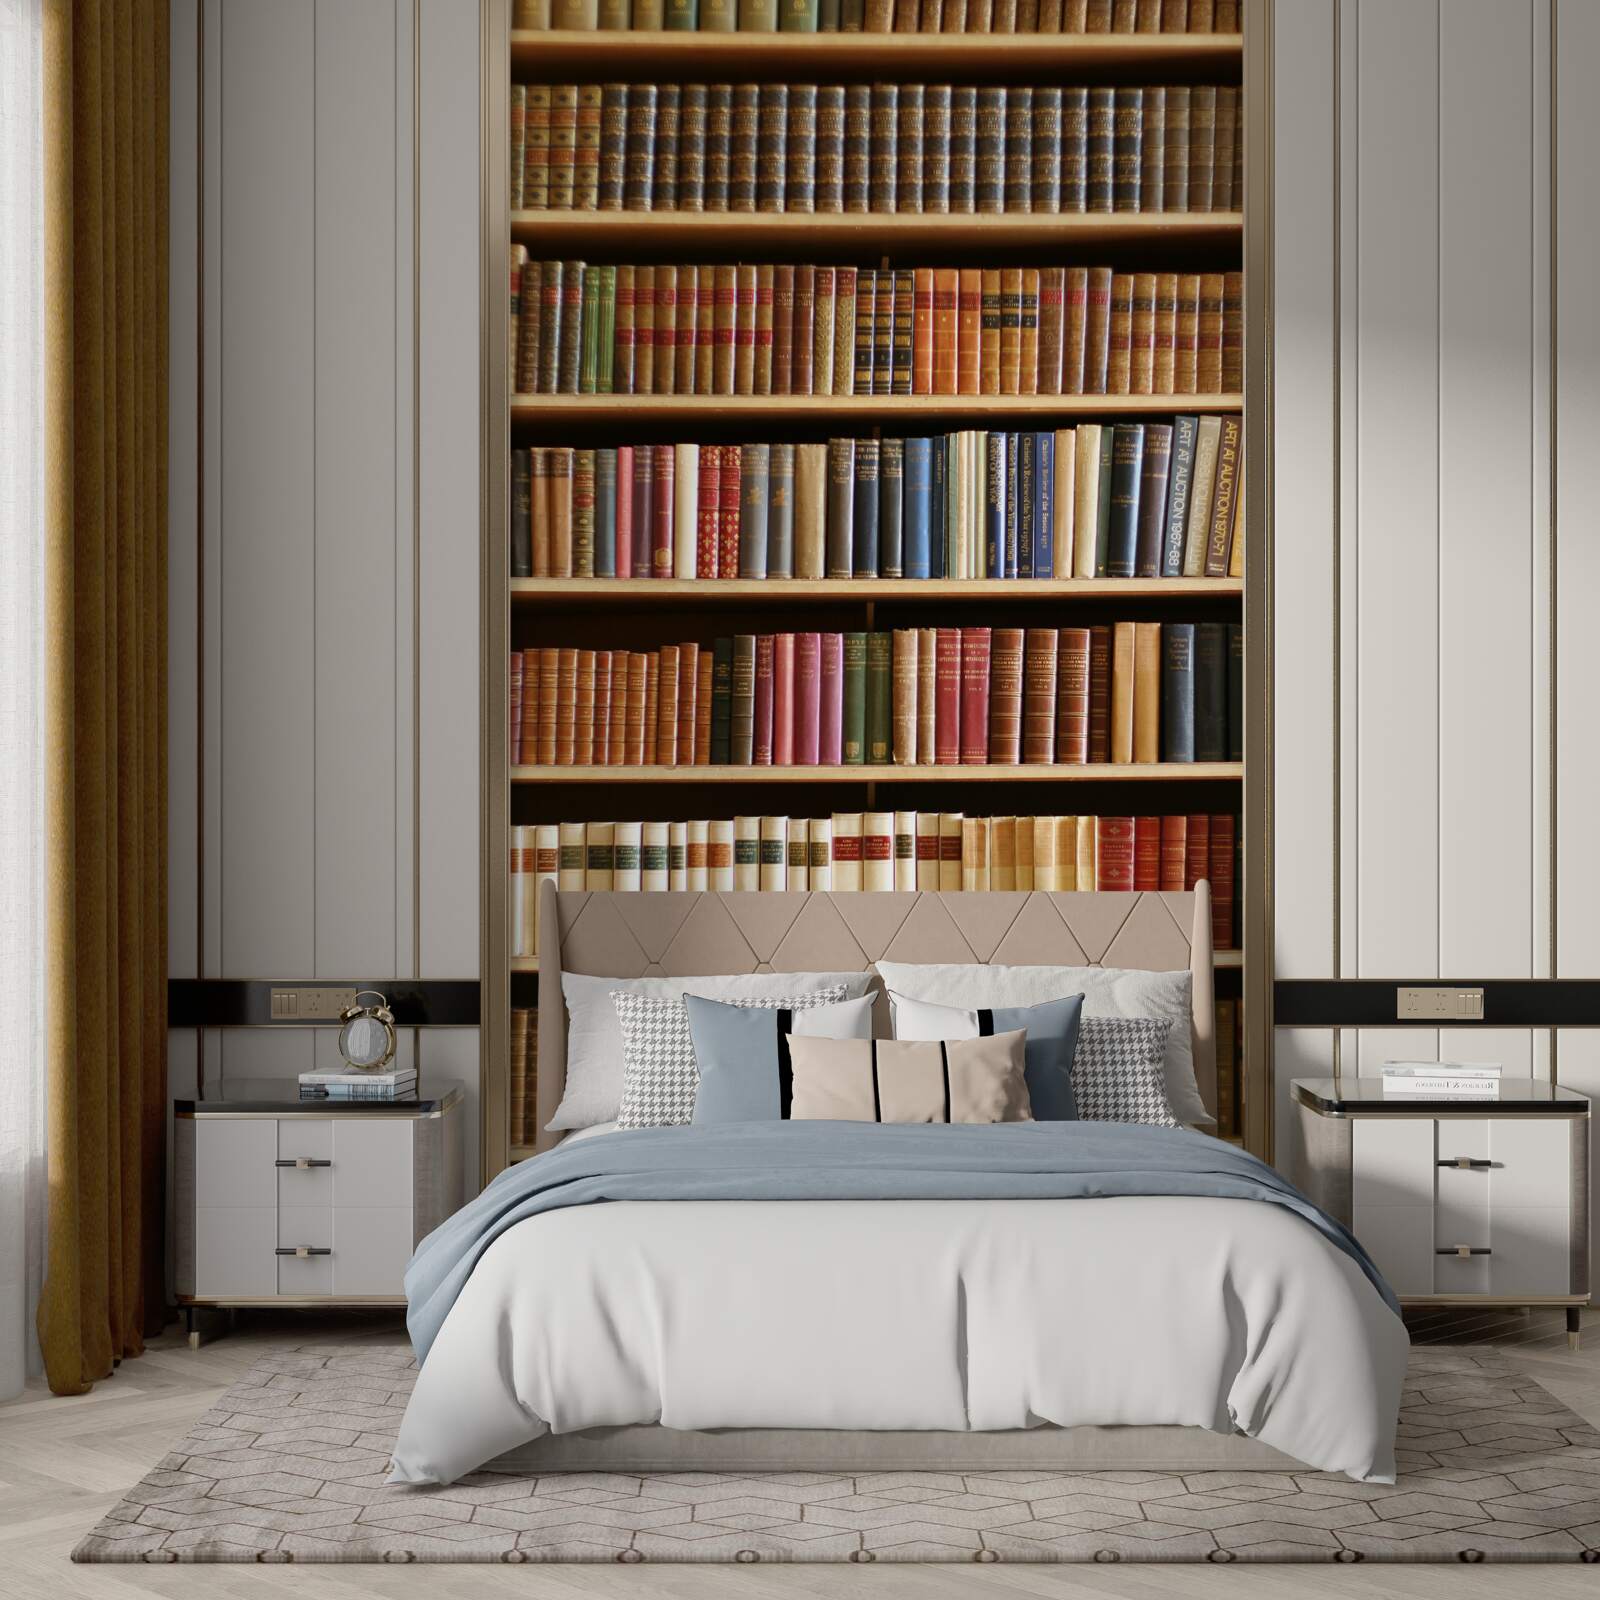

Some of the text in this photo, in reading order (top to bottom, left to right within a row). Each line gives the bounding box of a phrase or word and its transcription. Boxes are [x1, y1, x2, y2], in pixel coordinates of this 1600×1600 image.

[1225, 421, 1238, 448] ART
[1222, 448, 1234, 462] AT
[1168, 420, 1192, 566] ART AT AUCTION 1967-68
[1216, 464, 1233, 517] AUCTION
[1212, 518, 1226, 556] 1970-71
